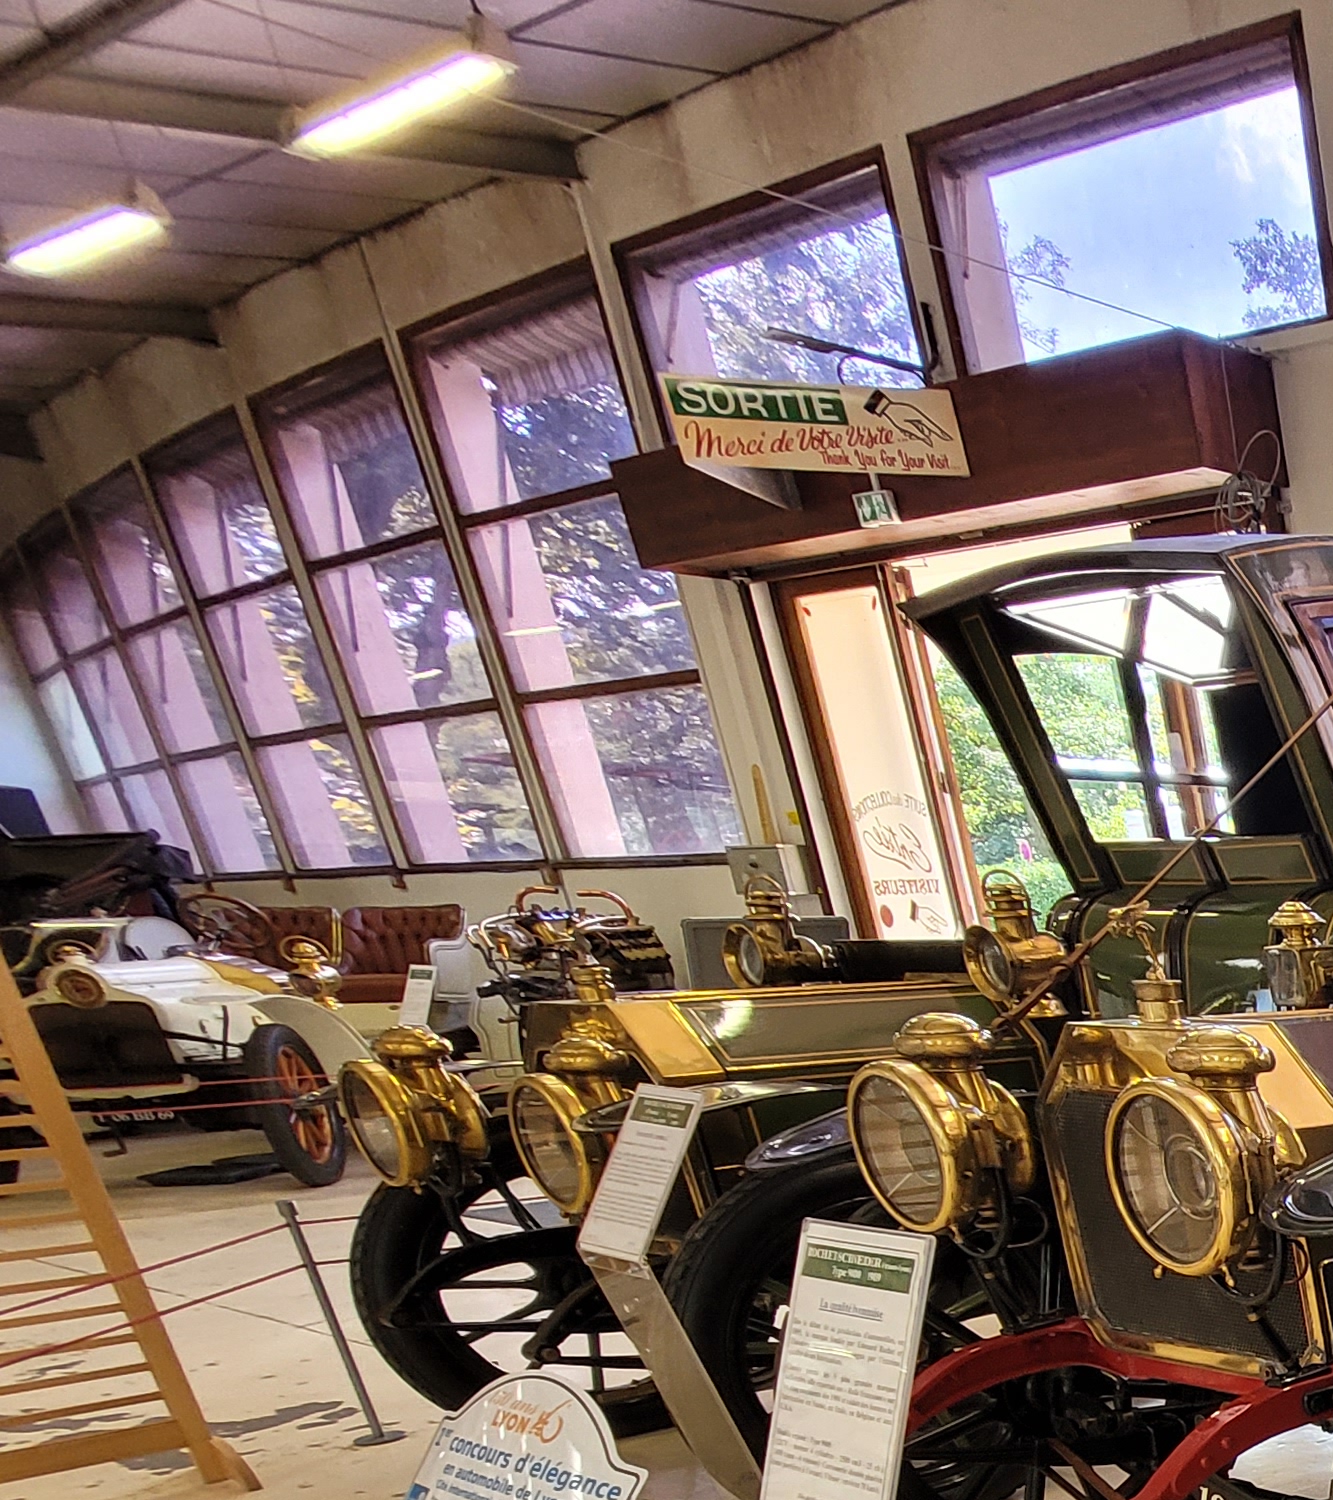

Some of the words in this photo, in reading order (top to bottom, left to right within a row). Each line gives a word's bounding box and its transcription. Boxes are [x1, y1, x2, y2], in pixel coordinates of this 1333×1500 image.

[676, 381, 840, 422] SORTIE
[684, 420, 764, 458] Merci
[771, 429, 794, 453] de
[797, 426, 842, 451] Votre
[819, 451, 851, 466] Thank
[855, 449, 877, 470] You
[880, 450, 896, 467] for
[898, 449, 925, 471] Your
[491, 1409, 530, 1434] LYON
[448, 1434, 512, 1470] concours
[442, 1463, 455, 1476] en
[455, 1466, 514, 1496] automobile
